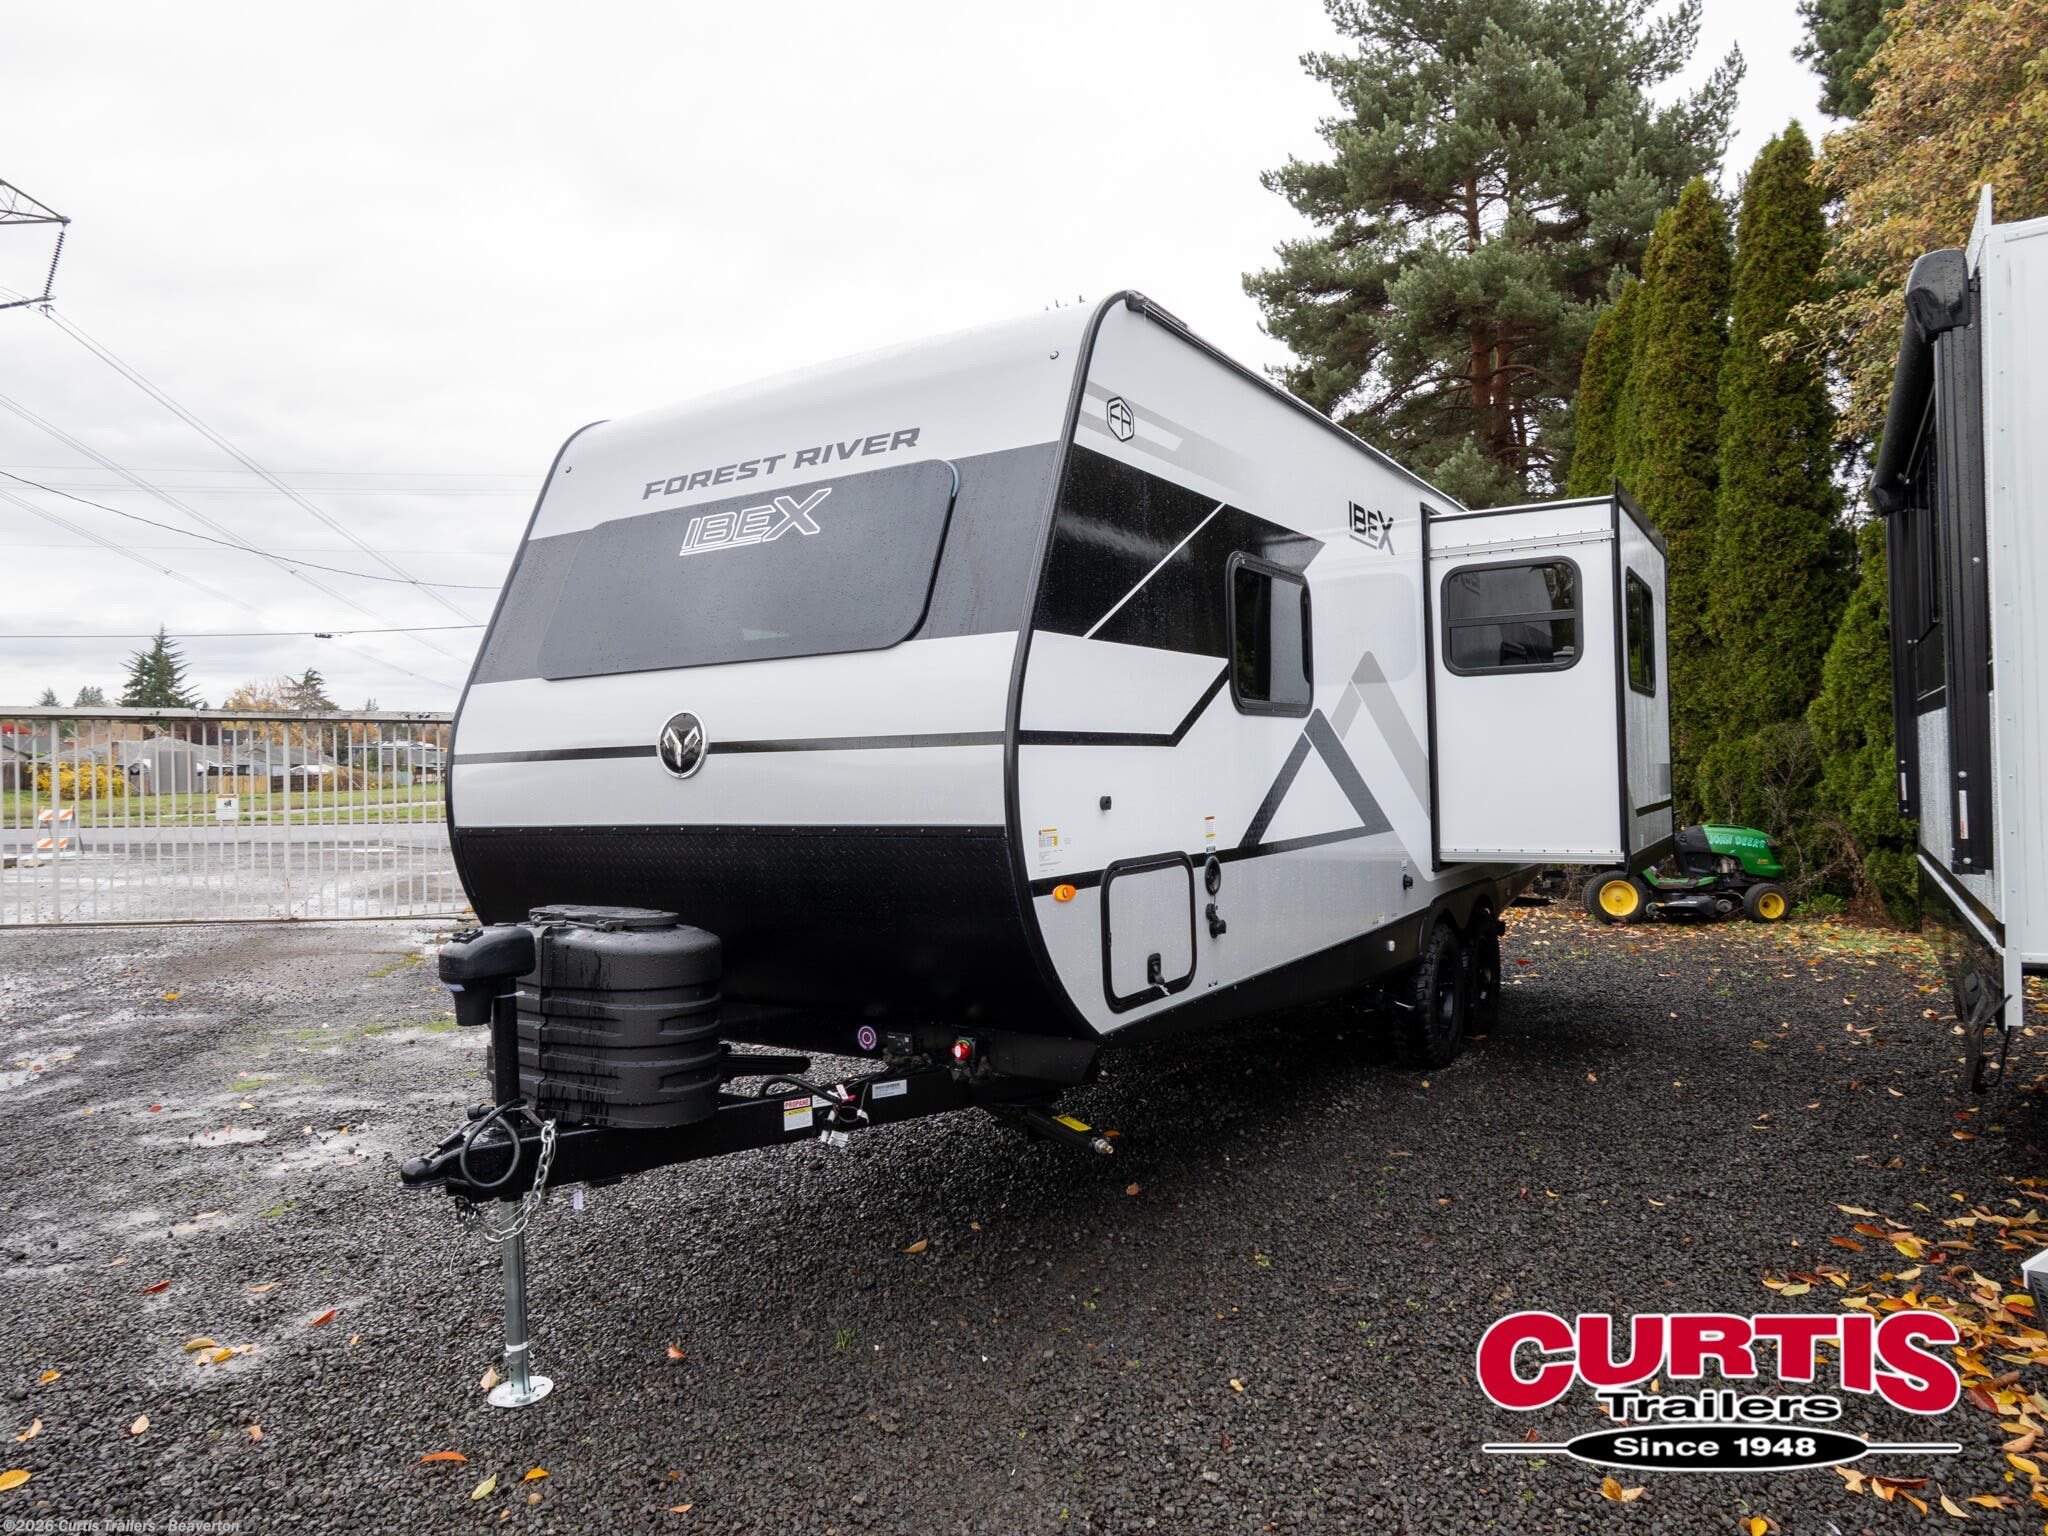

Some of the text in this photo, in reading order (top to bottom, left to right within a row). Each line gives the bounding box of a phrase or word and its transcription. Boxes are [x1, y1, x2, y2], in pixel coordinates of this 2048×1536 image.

[642, 427, 920, 500] FOREST RIVER
[680, 488, 832, 554] IBEX
[1348, 500, 1395, 556] IBEX
